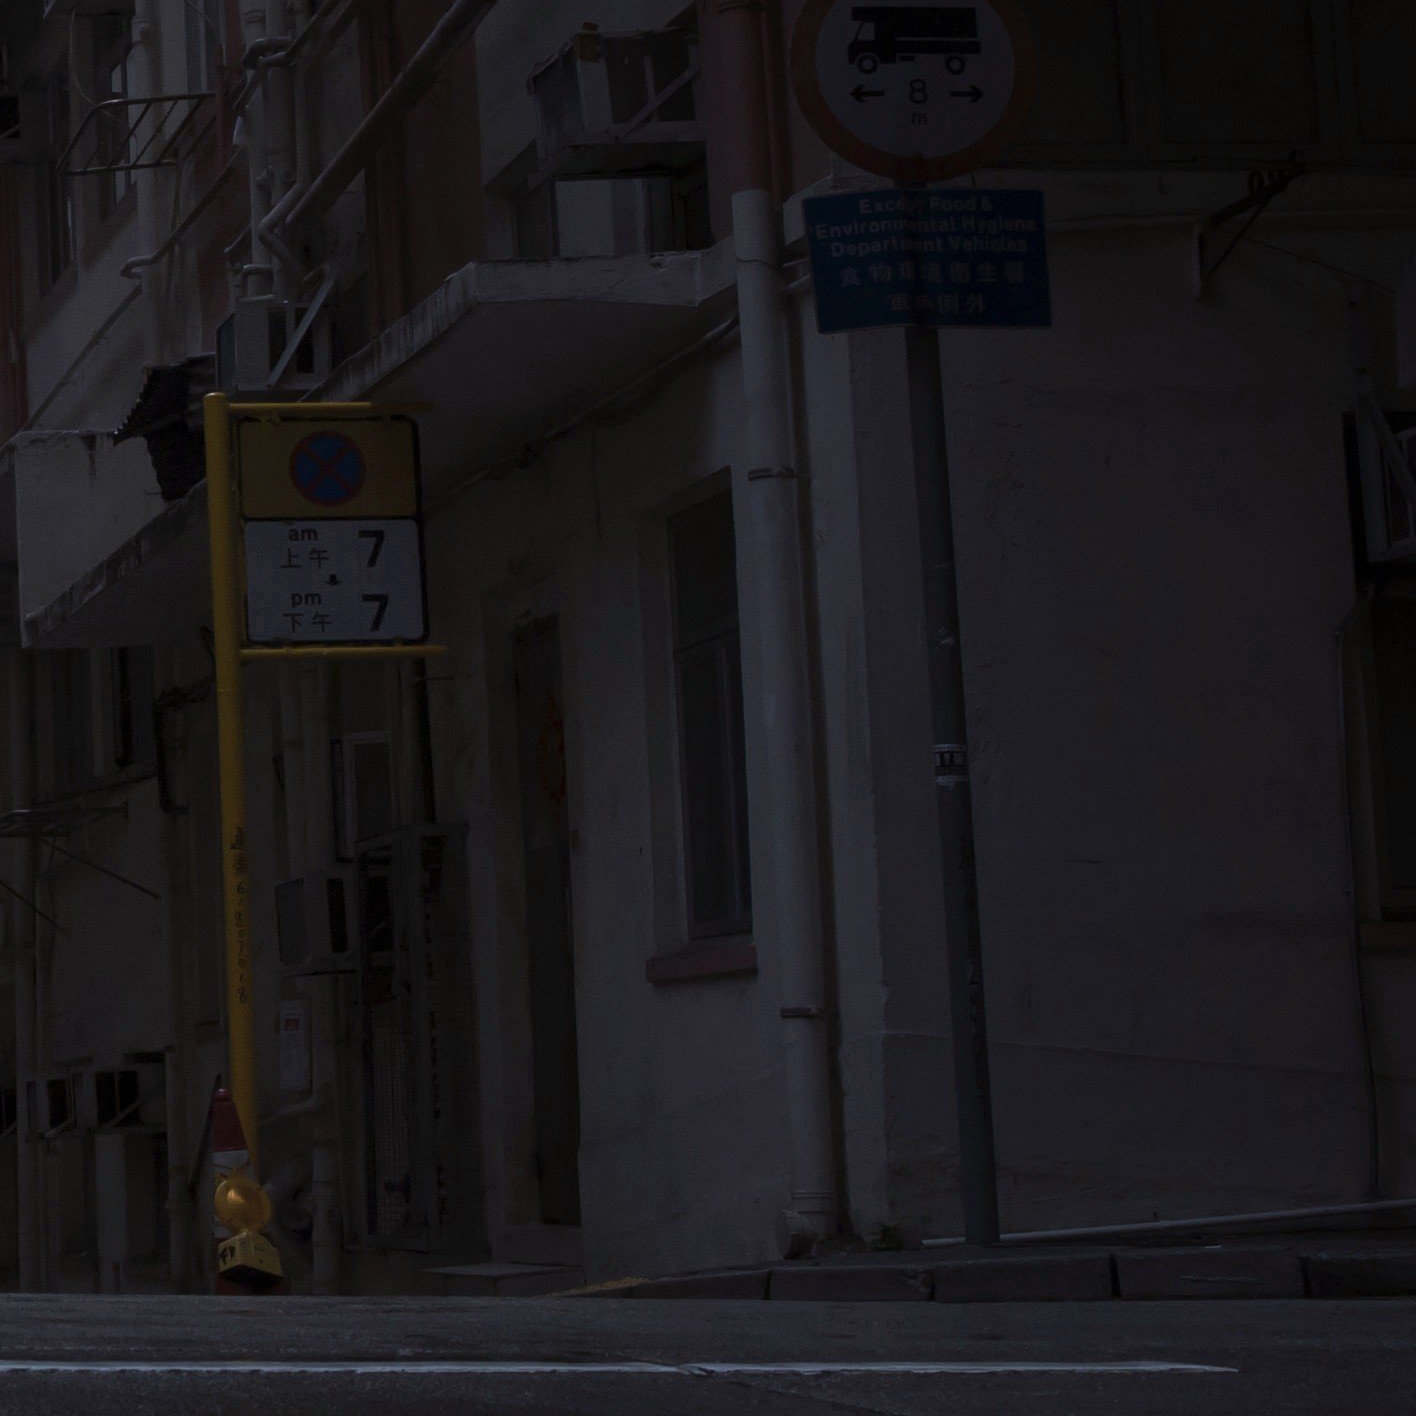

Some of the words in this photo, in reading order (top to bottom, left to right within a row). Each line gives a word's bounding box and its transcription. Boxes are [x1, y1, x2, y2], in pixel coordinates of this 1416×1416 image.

[908, 78, 928, 104] 8
[929, 196, 976, 213] Food
[981, 195, 994, 212] &
[961, 216, 1038, 235] Hygiene
[830, 236, 945, 258] Department
[948, 235, 1028, 253] Vehicles
[288, 528, 318, 541] am
[280, 547, 329, 569] 上午
[358, 530, 385, 568] 7
[291, 592, 322, 608] pm
[283, 611, 333, 634] 下午
[362, 594, 389, 632] 7
